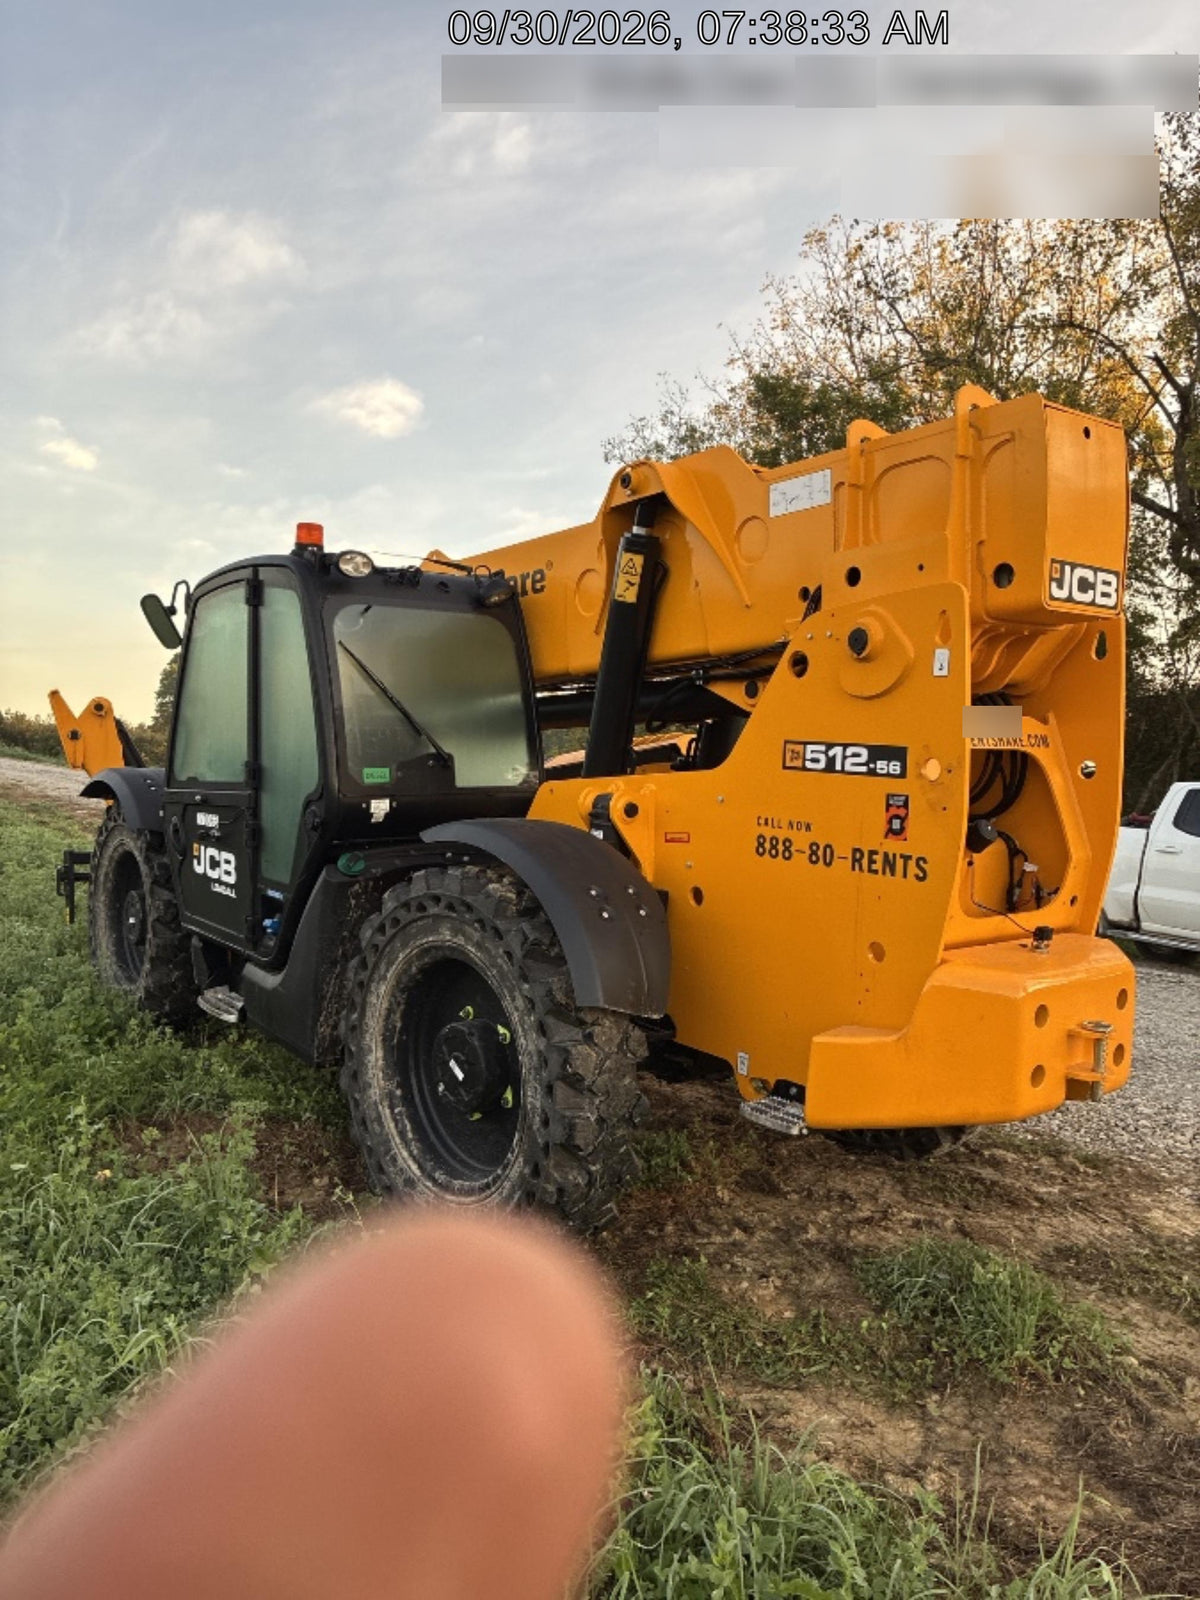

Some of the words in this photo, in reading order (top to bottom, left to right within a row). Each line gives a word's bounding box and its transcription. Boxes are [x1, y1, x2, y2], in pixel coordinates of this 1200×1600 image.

[1050, 564, 1119, 607] JCB
[804, 744, 901, 775] 512-56
[757, 816, 783, 829] CALL
[787, 819, 812, 832] NOW
[193, 844, 237, 884] JCB
[755, 834, 929, 882] 888-80-RENTS
